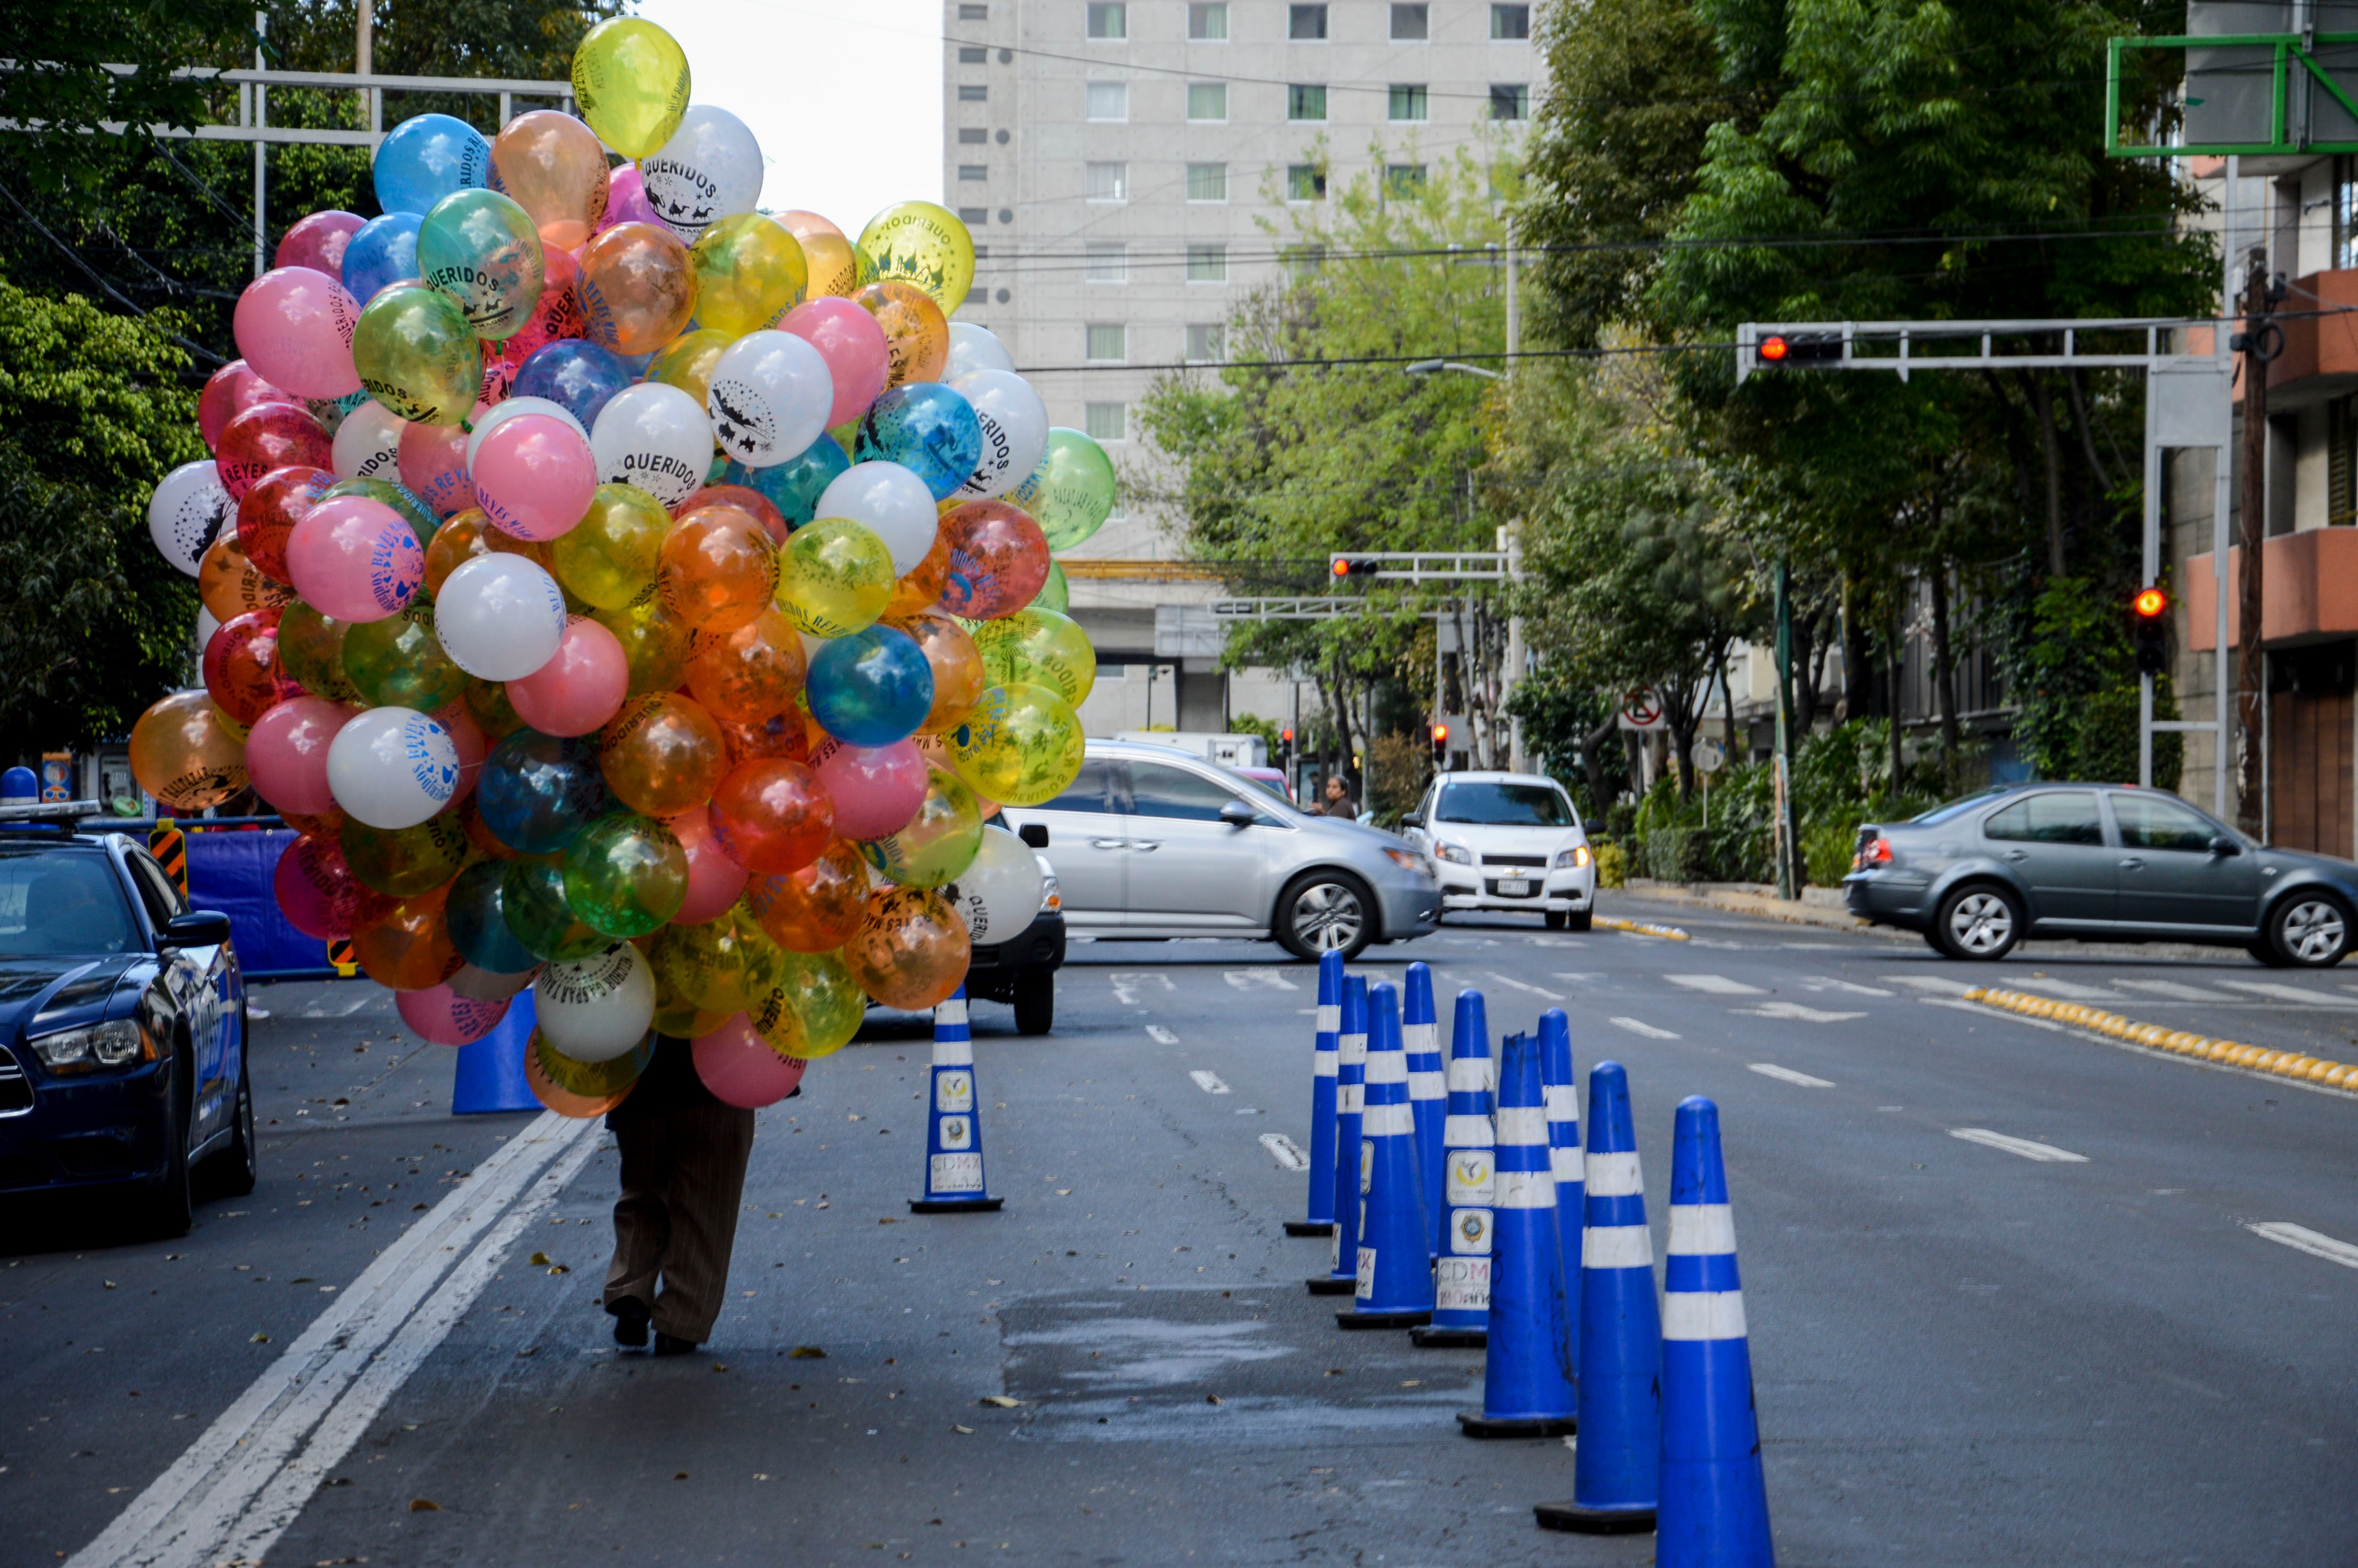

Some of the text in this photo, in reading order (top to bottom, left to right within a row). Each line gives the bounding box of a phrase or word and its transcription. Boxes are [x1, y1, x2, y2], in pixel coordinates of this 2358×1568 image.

[460, 145, 475, 188] RIDOS
[645, 159, 716, 198] QUERIDOS
[427, 266, 499, 293] QUERIDOS
[546, 286, 575, 335] QUER
[762, 301, 793, 330] RIDOS
[361, 379, 408, 399] RIDOS
[479, 371, 501, 403] RIDOS
[978, 409, 1010, 470] ERIDOS
[225, 462, 268, 484] REYES
[357, 448, 397, 477] RIDOS
[624, 453, 696, 490] QUERIDOS
[480, 486, 510, 520] REYES
[969, 895, 988, 941] QUERID
[559, 981, 607, 1004] GASPAR
[1439, 1260, 1488, 1282] CDM
